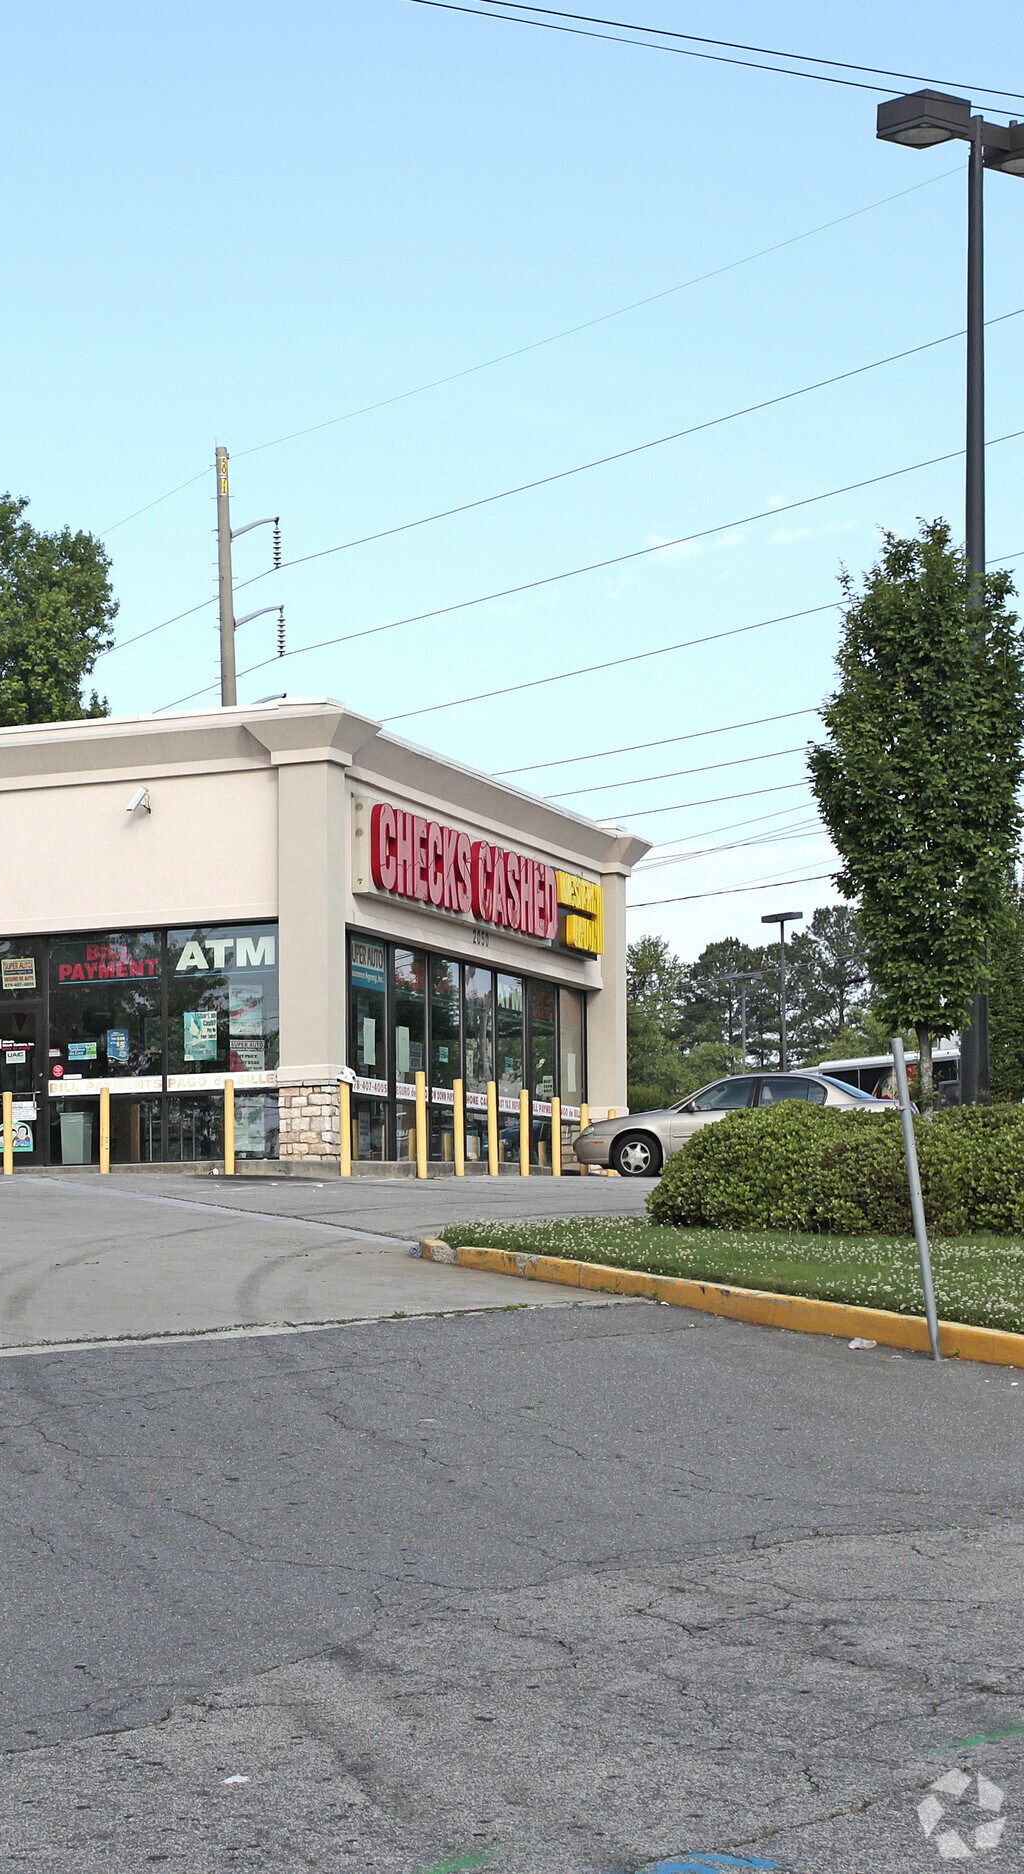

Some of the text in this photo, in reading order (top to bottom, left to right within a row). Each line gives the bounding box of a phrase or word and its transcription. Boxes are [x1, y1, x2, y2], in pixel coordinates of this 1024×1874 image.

[371, 803, 558, 939] CHECKS CASHED
[86, 943, 133, 960] BILL
[176, 936, 275, 970] ATM
[367, 947, 384, 970] AUTO
[3, 961, 32, 970] SUPER AUTO
[59, 959, 158, 980] PAYMENT
[50, 1079, 163, 1093] BILL PAYMENTS
[168, 1077, 206, 1089] PAGO
